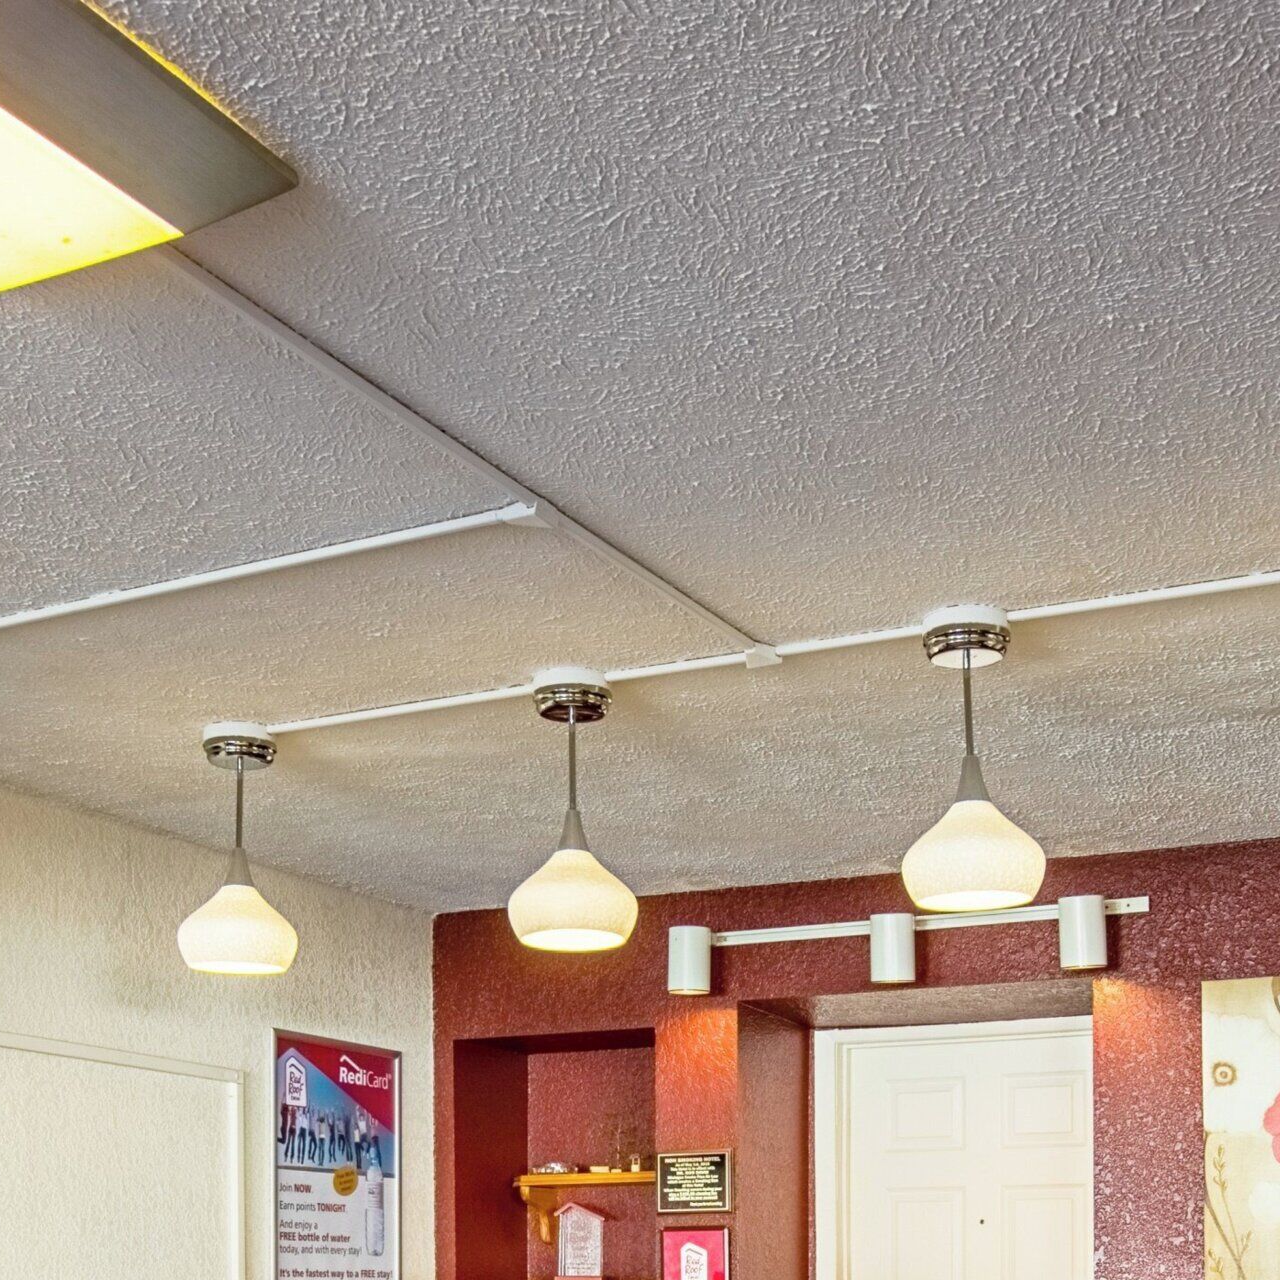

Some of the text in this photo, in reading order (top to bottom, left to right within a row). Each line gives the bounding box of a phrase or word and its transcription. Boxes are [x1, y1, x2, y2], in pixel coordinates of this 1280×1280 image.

[279, 1183, 293, 1193] Join
[279, 1201, 295, 1211] Earn
[296, 1202, 316, 1213] points
[280, 1220, 293, 1229] And
[294, 1220, 312, 1231] enjoy
[280, 1232, 351, 1243] FREE bottle of water
[280, 1245, 299, 1256] today,
[301, 1245, 313, 1254] and
[315, 1245, 329, 1255] with
[330, 1247, 347, 1256] every
[280, 1269, 290, 1278] It's
[292, 1268, 304, 1278] the
[306, 1268, 329, 1278] fastest
[331, 1271, 344, 1280] way
[346, 1270, 353, 1278] to
[360, 1269, 375, 1278] FREE
